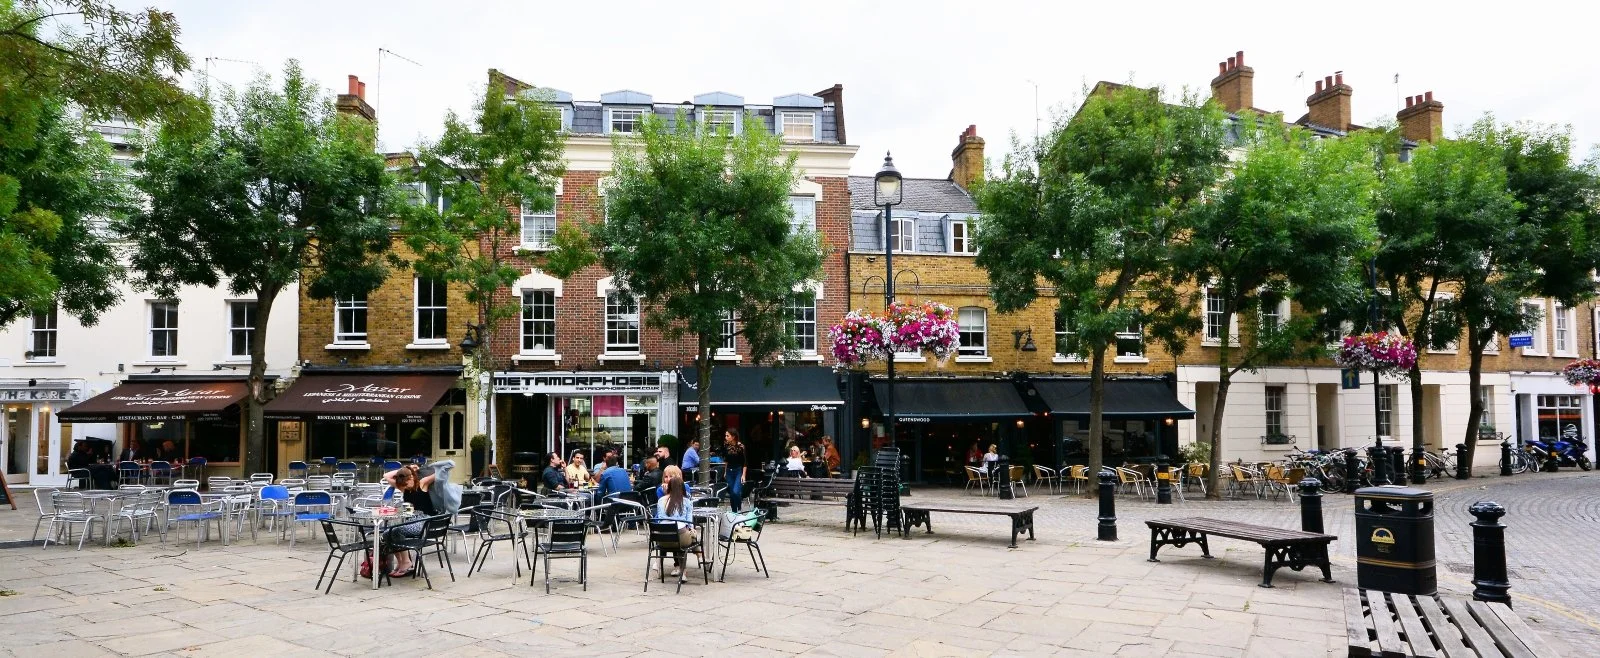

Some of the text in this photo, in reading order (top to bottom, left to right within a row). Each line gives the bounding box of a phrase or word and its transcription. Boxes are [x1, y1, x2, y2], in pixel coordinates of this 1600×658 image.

[494, 377, 660, 386] METAMORPHOSIS
[324, 383, 411, 393] Mazar
[1, 390, 26, 400] THE
